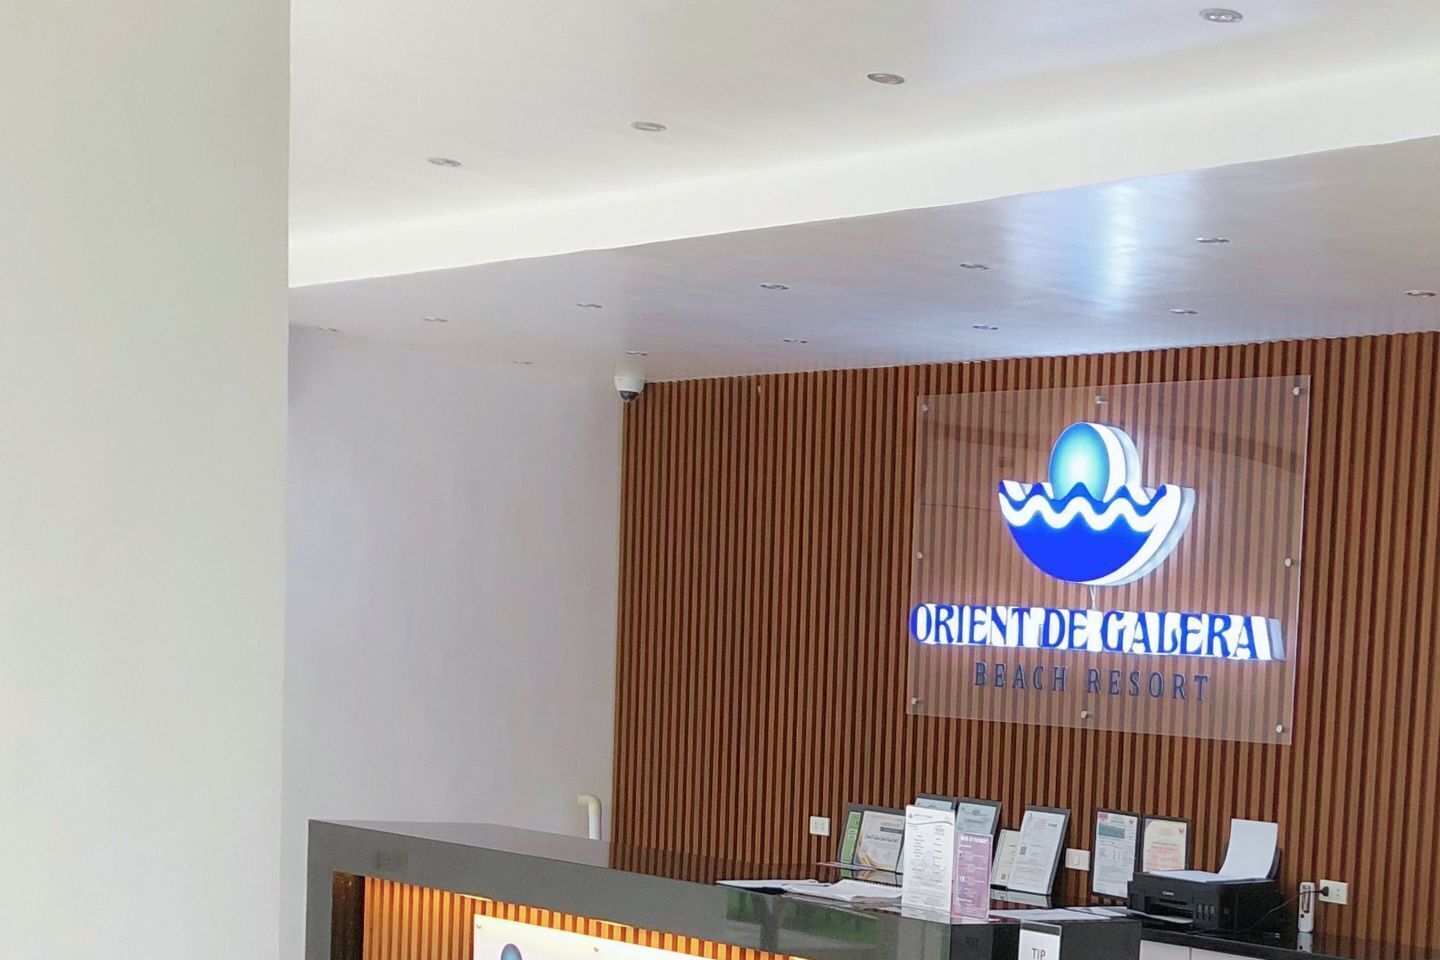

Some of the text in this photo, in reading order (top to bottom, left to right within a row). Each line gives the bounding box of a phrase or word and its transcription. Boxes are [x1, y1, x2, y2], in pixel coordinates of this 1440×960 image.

[911, 603, 1258, 659] ORIENT DE GALERA
[974, 661, 1209, 701] BEACH RESORT
[1032, 948, 1046, 960] TIP
